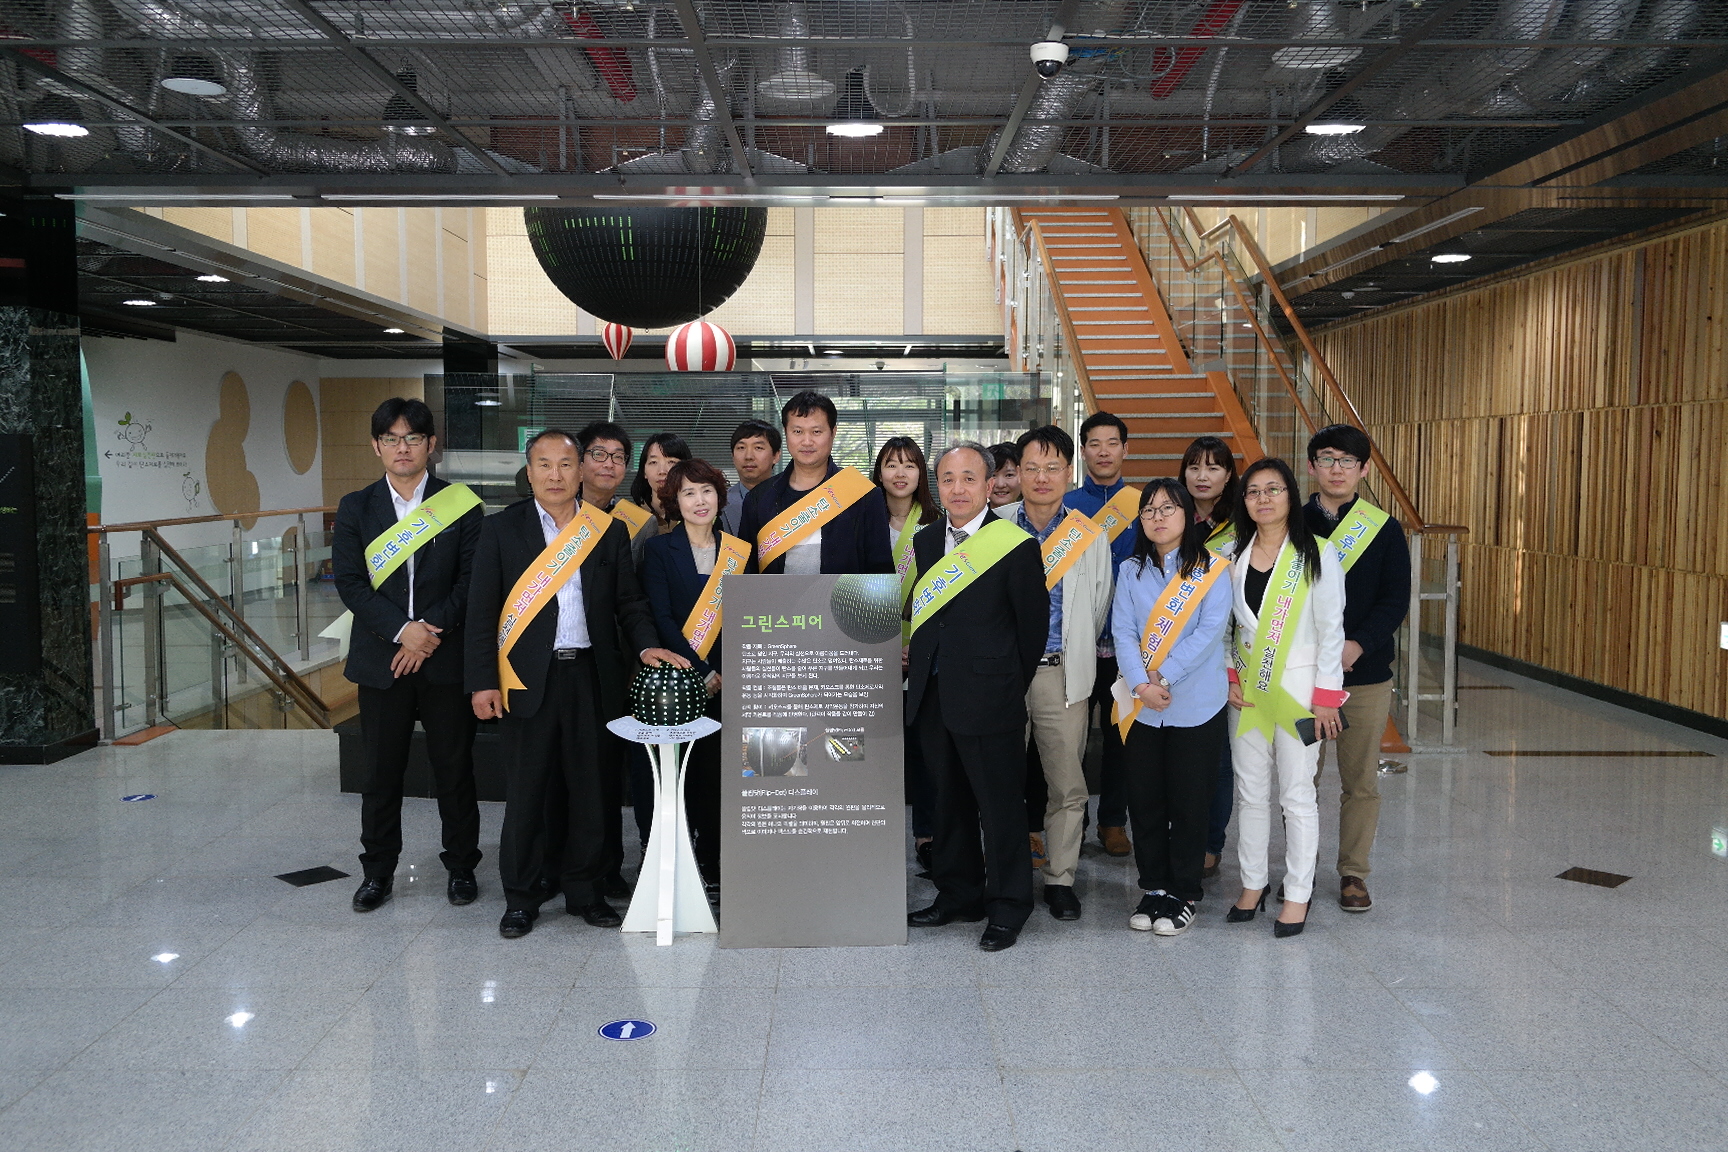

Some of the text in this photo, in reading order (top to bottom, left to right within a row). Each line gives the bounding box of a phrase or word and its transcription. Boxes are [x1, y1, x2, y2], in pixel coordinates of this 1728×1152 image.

[780, 497, 830, 538] 탄소줄이기
[370, 518, 430, 572] 기후변화
[546, 525, 591, 576] 탄소줄이기
[513, 571, 552, 616] 내가먼저
[912, 563, 964, 617] 기후변화
[741, 614, 823, 632] 그린스피어
[1266, 595, 1293, 646] 내가먼저
[1255, 645, 1276, 692] 실천해요
[788, 788, 819, 797] 디스플레이
